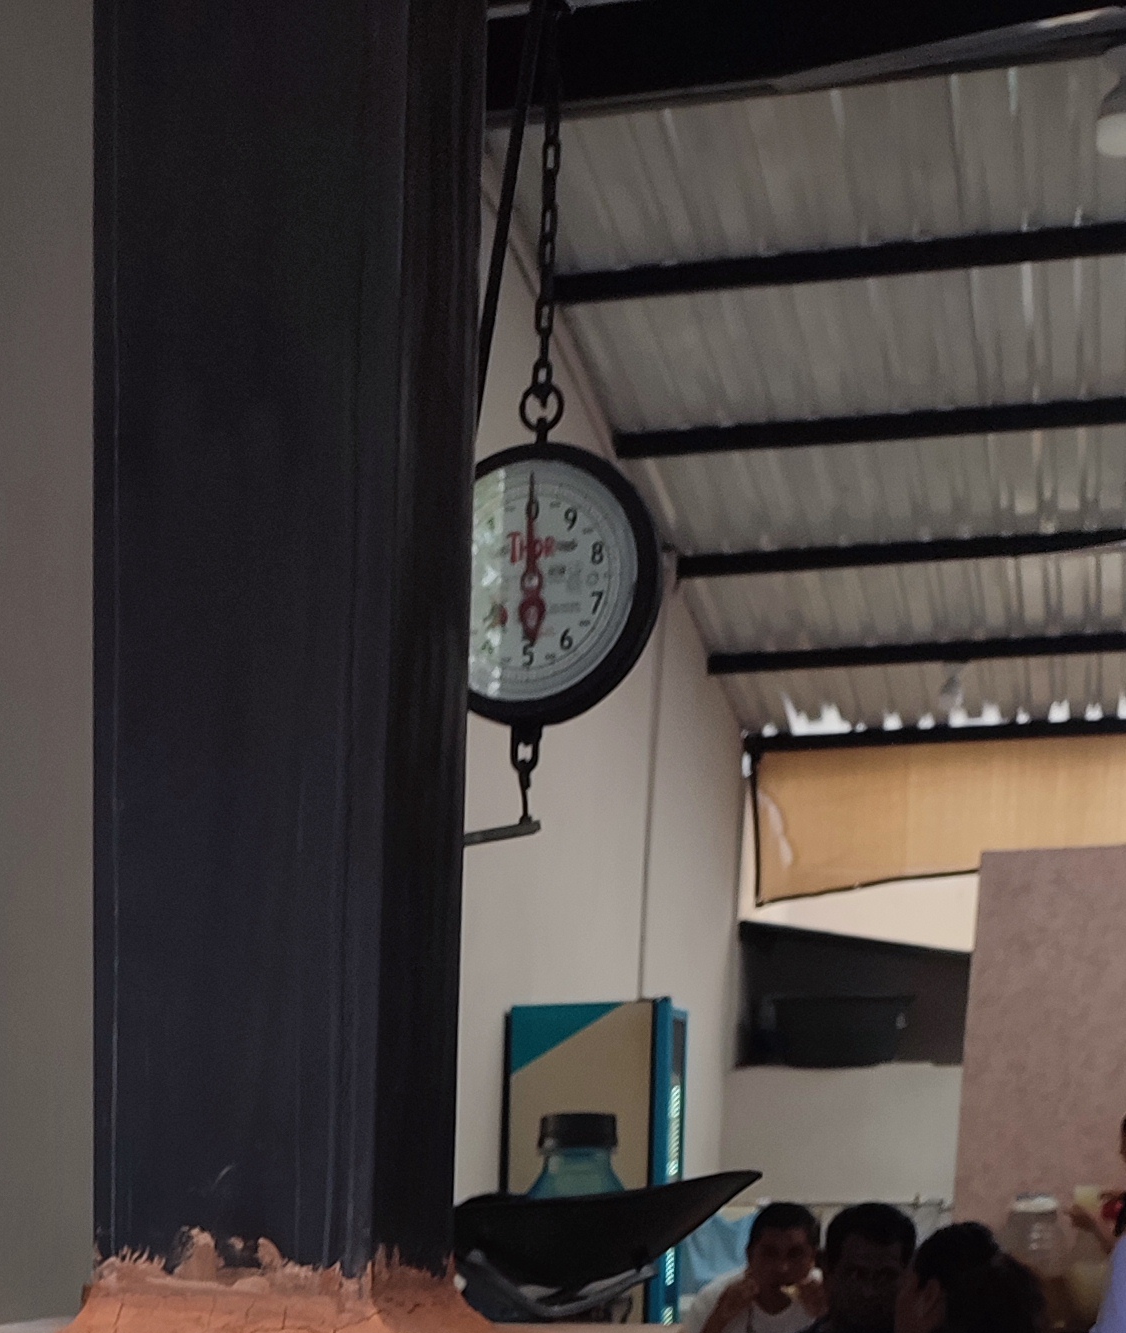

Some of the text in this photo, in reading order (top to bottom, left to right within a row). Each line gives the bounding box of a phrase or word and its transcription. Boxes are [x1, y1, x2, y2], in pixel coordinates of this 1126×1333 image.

[564, 508, 578, 531] 9
[591, 542, 605, 565] 8
[591, 591, 604, 615] 7
[560, 628, 574, 651] 6
[522, 642, 535, 668] 5
